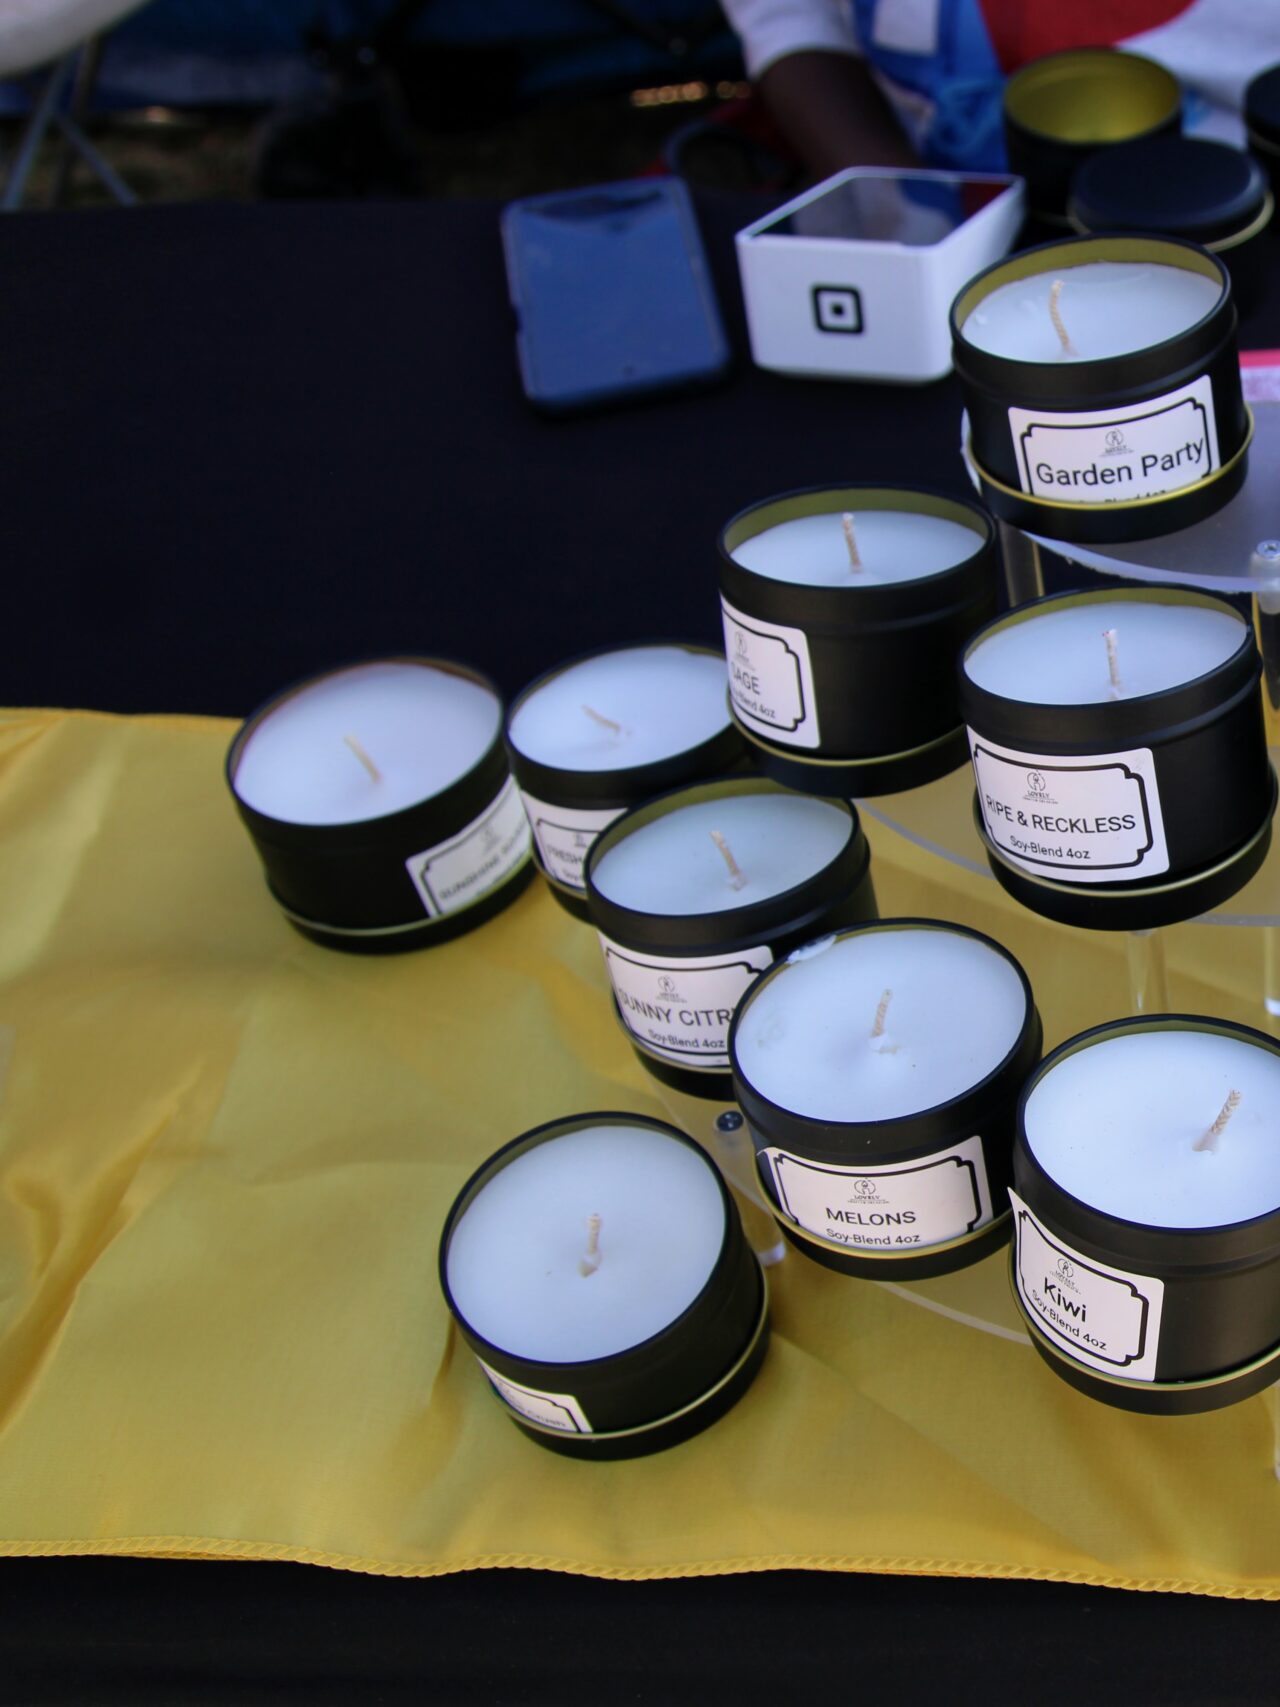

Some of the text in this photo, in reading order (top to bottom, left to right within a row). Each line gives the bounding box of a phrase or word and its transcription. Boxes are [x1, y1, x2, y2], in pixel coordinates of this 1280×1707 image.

[1035, 438, 1204, 486] Garden Party
[985, 794, 1015, 822] RIPE
[1017, 810, 1028, 827] &
[1031, 814, 1136, 834] RECKLESS
[1009, 835, 1090, 860] Soy-Blend 4oz
[680, 1007, 736, 1026] CITR
[702, 1038, 725, 1048] 4oz
[825, 1207, 917, 1226] MELONS
[825, 1228, 921, 1245] Soy-Blend 4oz
[1044, 1276, 1087, 1323] Kiwi
[1032, 1289, 1107, 1350] Soy-Blend 4oz
